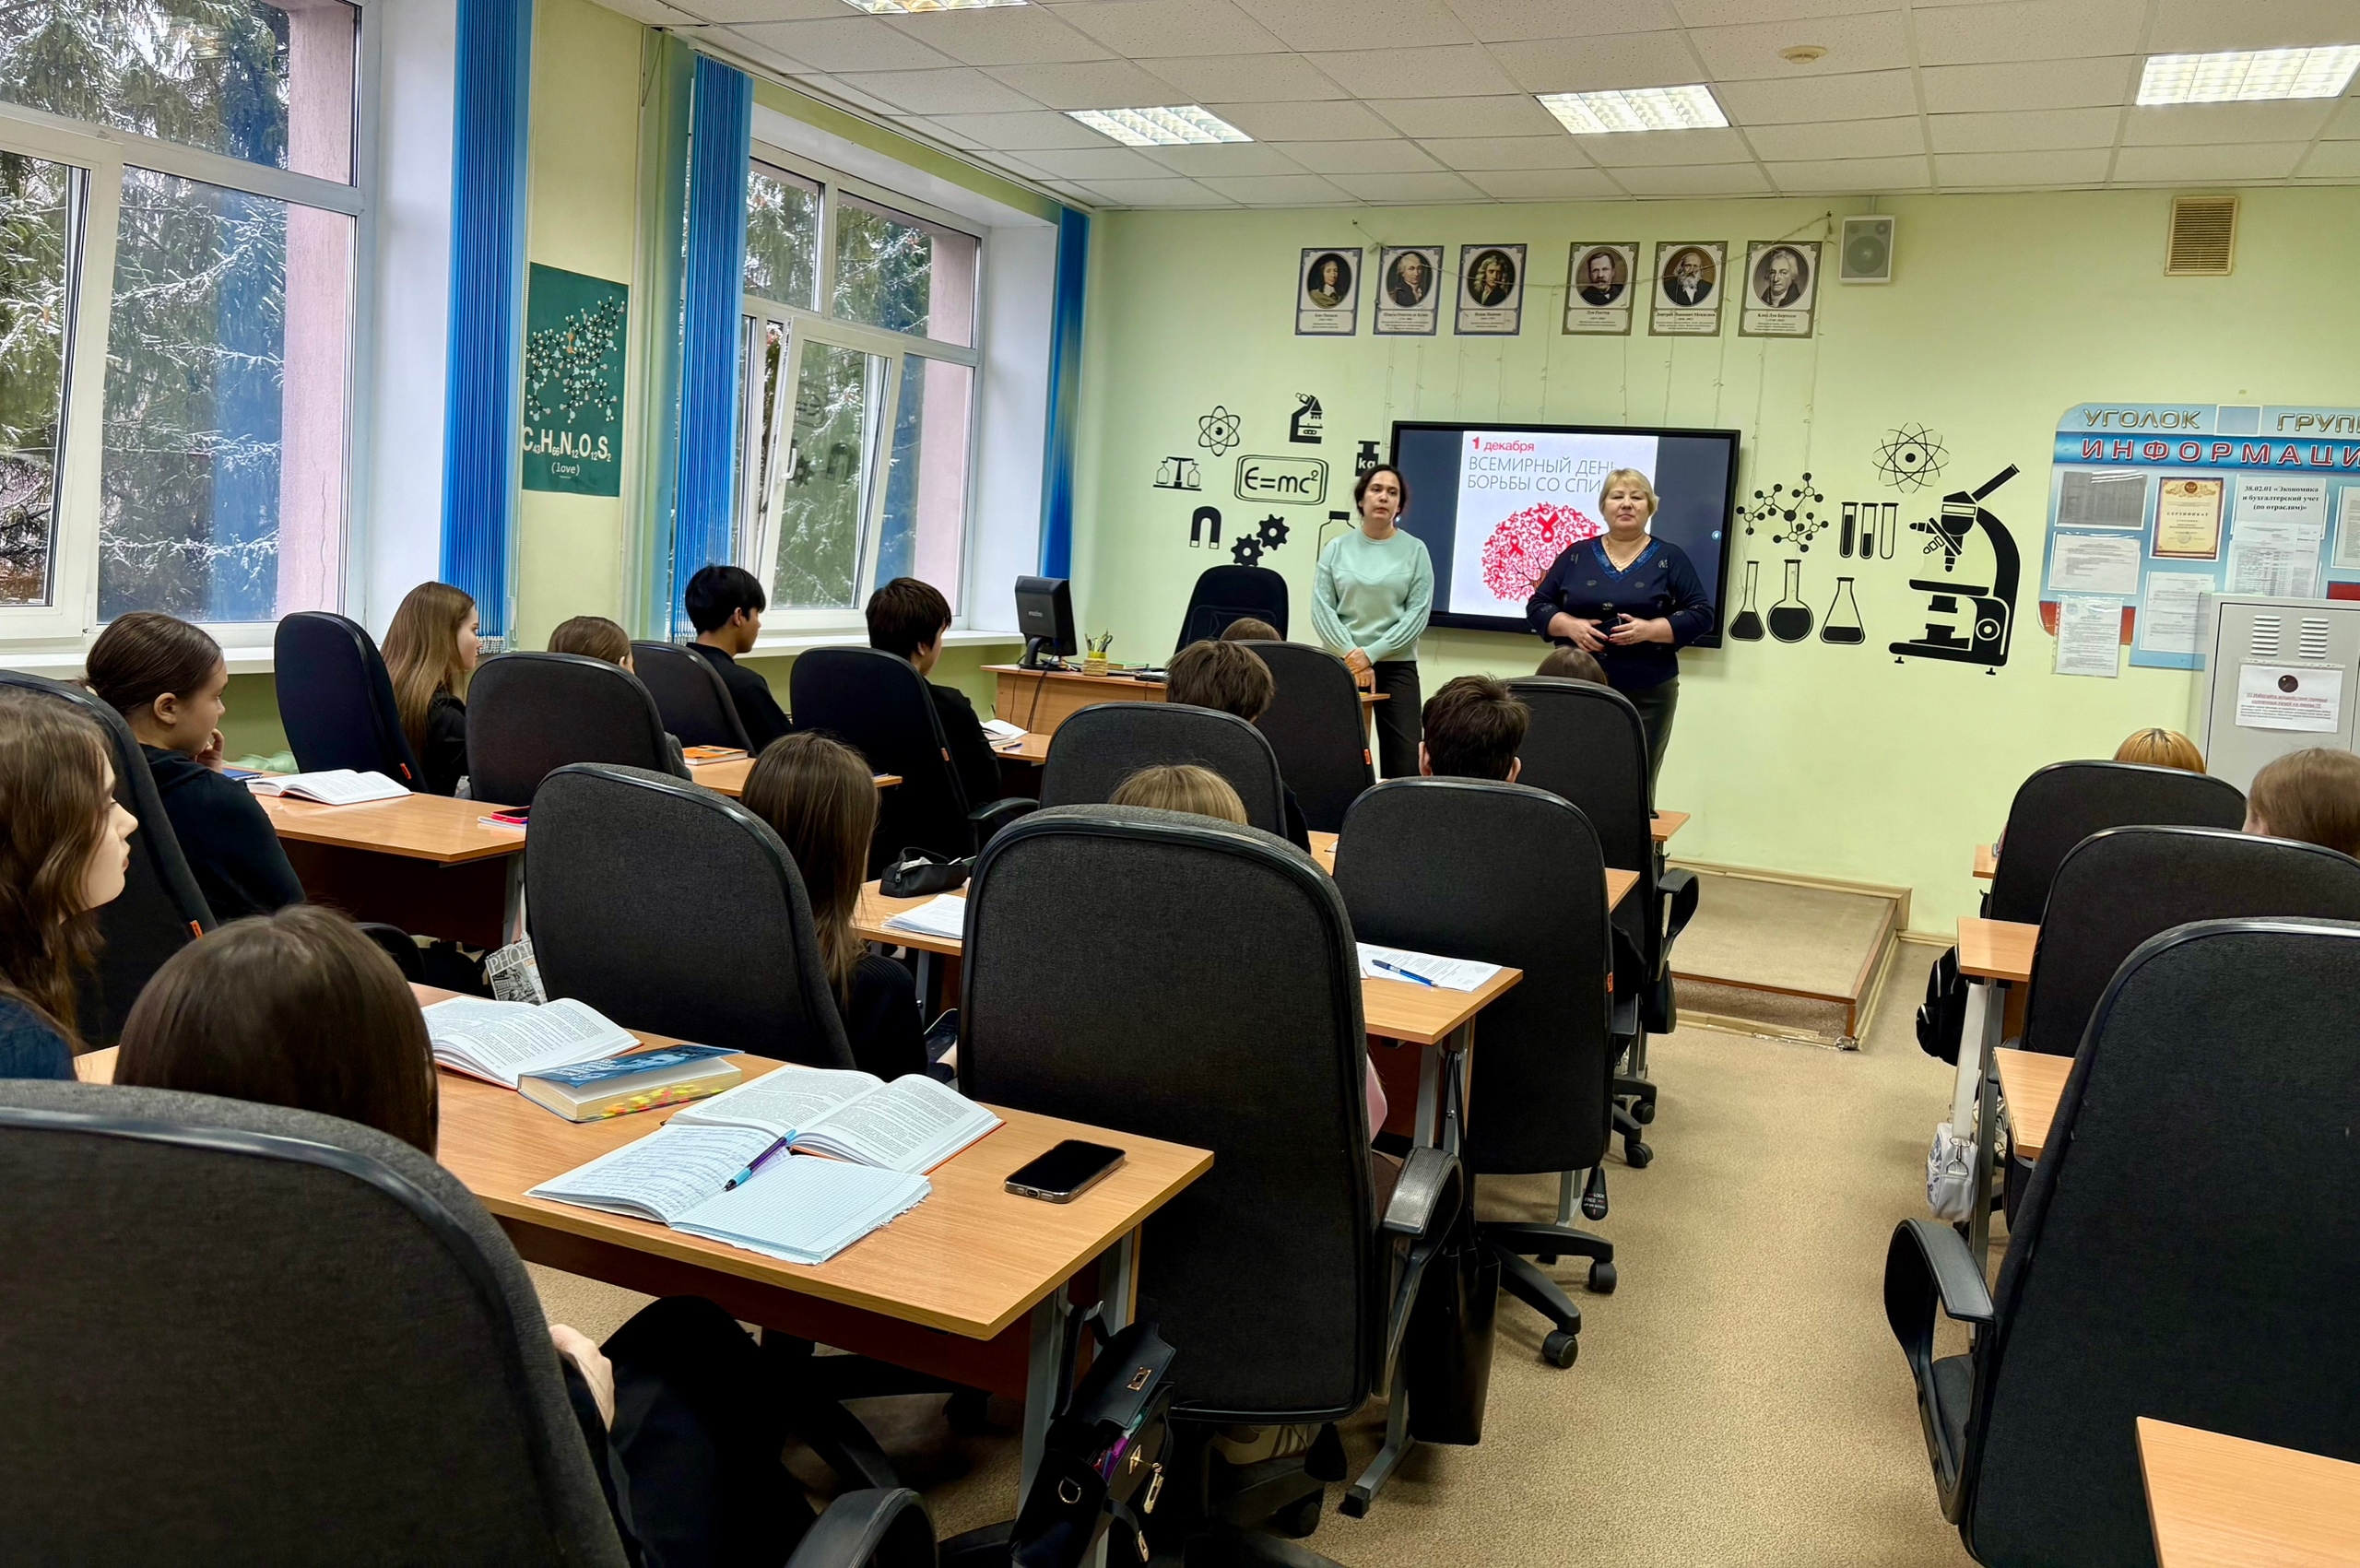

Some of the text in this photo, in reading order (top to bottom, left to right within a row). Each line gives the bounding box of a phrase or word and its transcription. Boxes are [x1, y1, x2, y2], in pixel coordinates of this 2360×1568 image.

[2083, 409, 2360, 433] УГОЛОК ГРУП
[1472, 436, 1535, 454] 1 декабря
[551, 462, 581, 477] (love)
[1469, 456, 1571, 474] ВСЕМИРНЫЙ
[1468, 475, 1531, 490] БОРЬБЫ
[1536, 477, 1560, 492] СО
